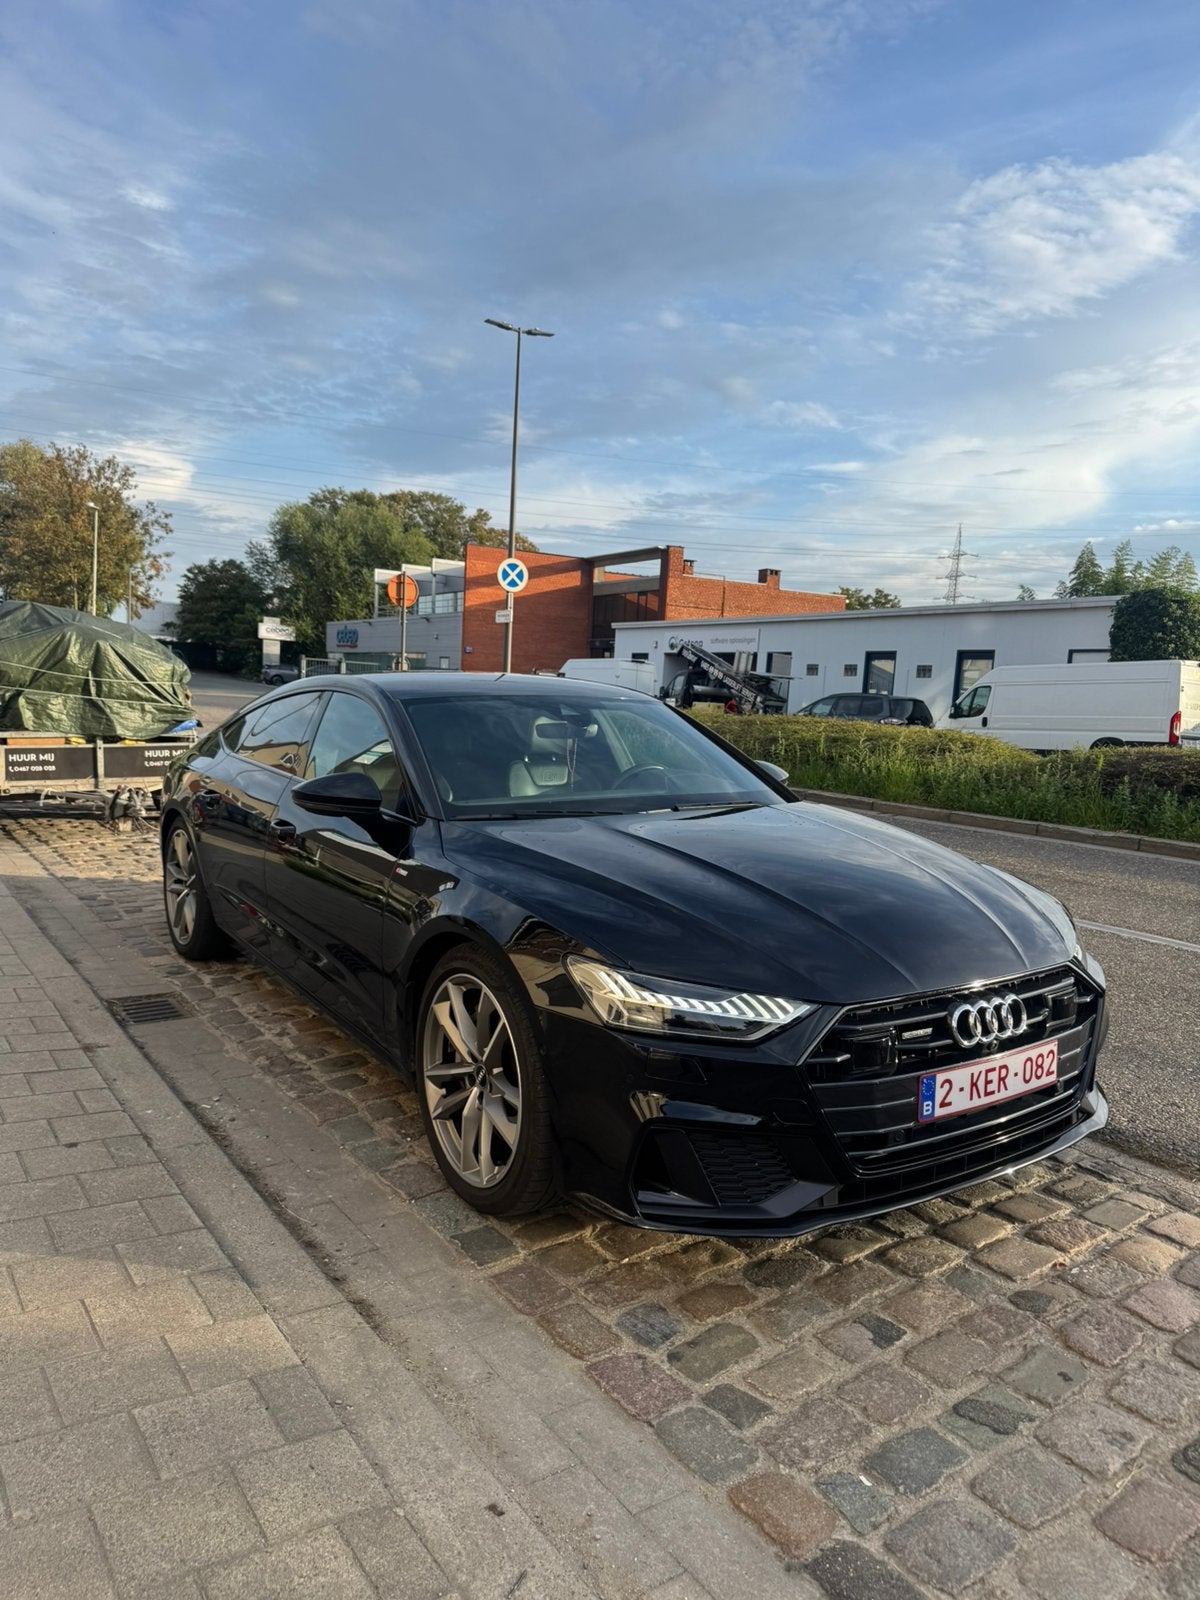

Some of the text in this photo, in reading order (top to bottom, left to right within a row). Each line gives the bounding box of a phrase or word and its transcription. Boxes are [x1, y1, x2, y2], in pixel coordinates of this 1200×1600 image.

[8, 752, 55, 762] HUUR MIJ
[923, 1100, 933, 1116] B
